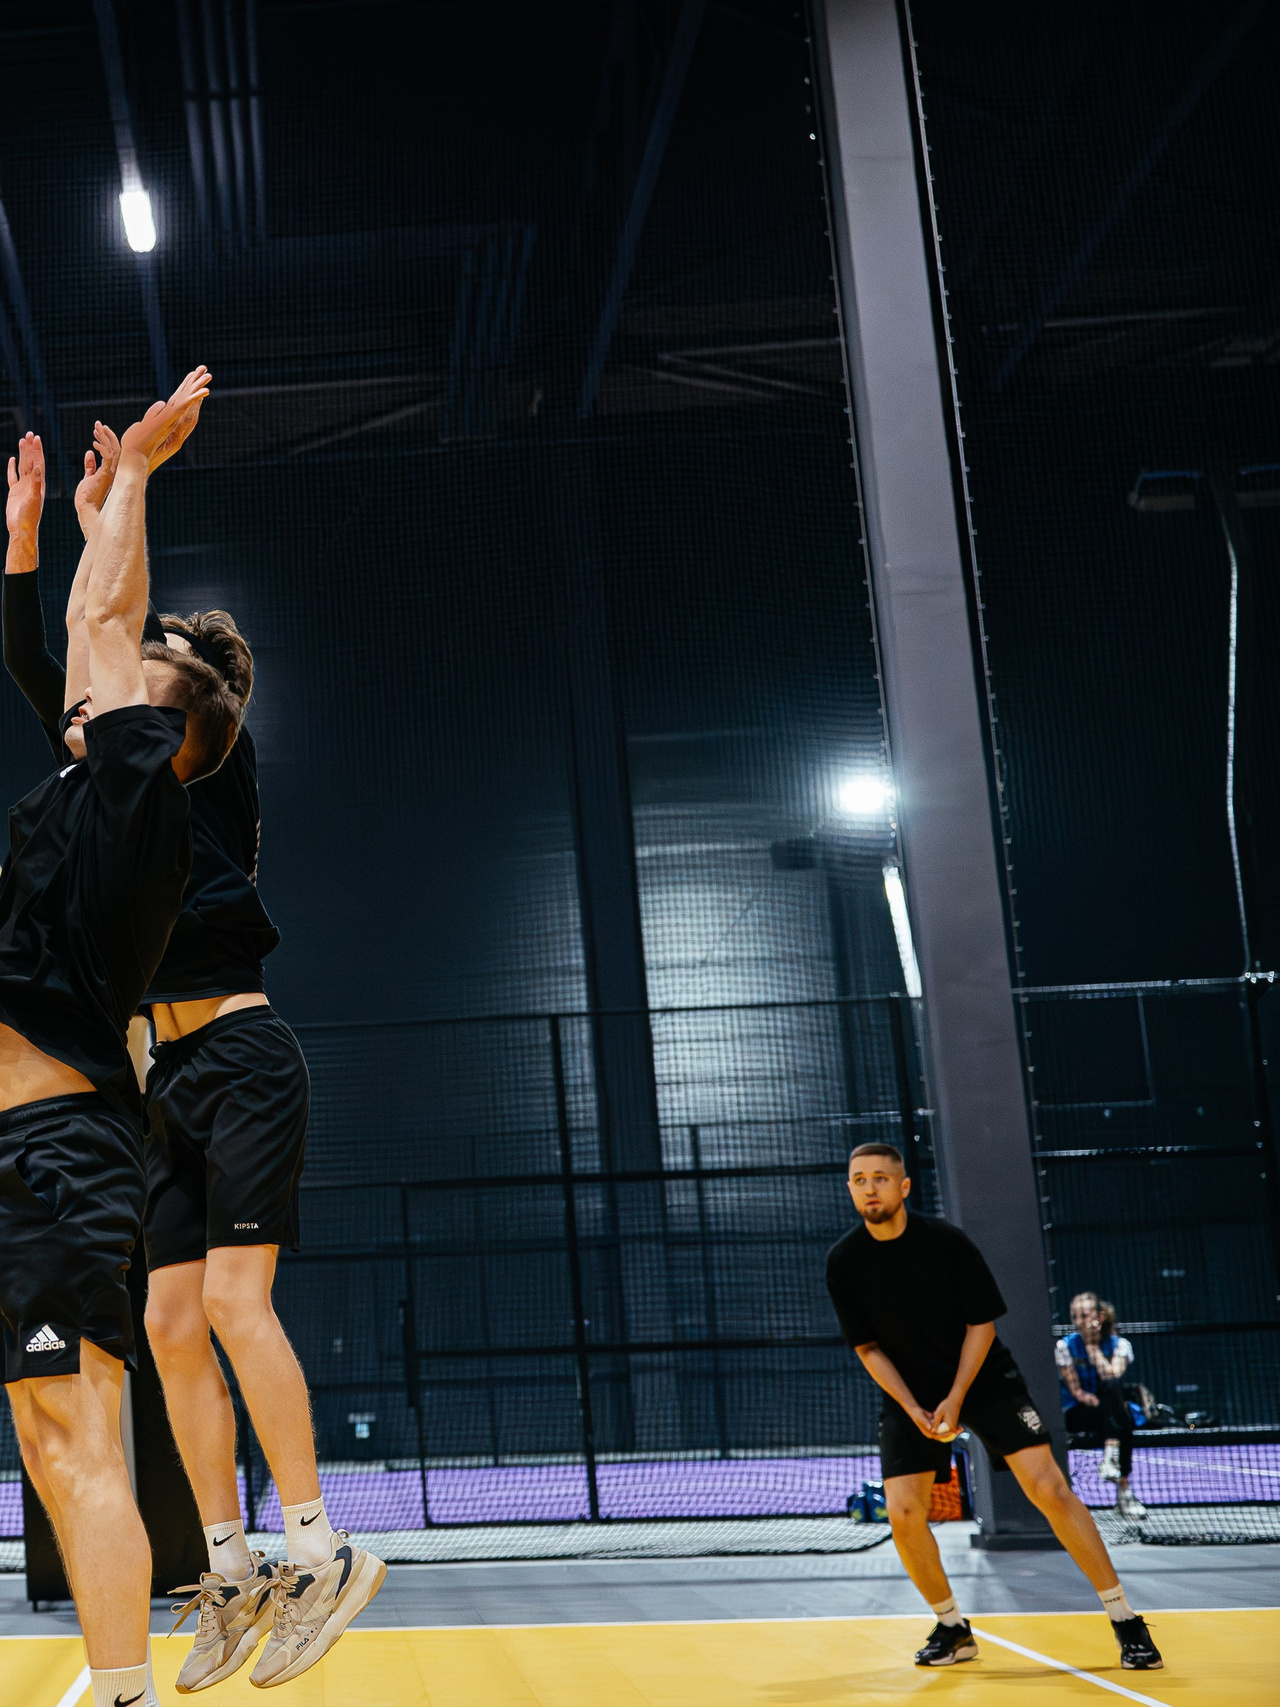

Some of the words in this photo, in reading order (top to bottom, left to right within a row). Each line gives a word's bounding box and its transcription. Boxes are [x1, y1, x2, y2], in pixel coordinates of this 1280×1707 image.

[234, 1222, 259, 1230] KIPSTA
[26, 1340, 66, 1353] adidas
[295, 1637, 310, 1651] FILA
